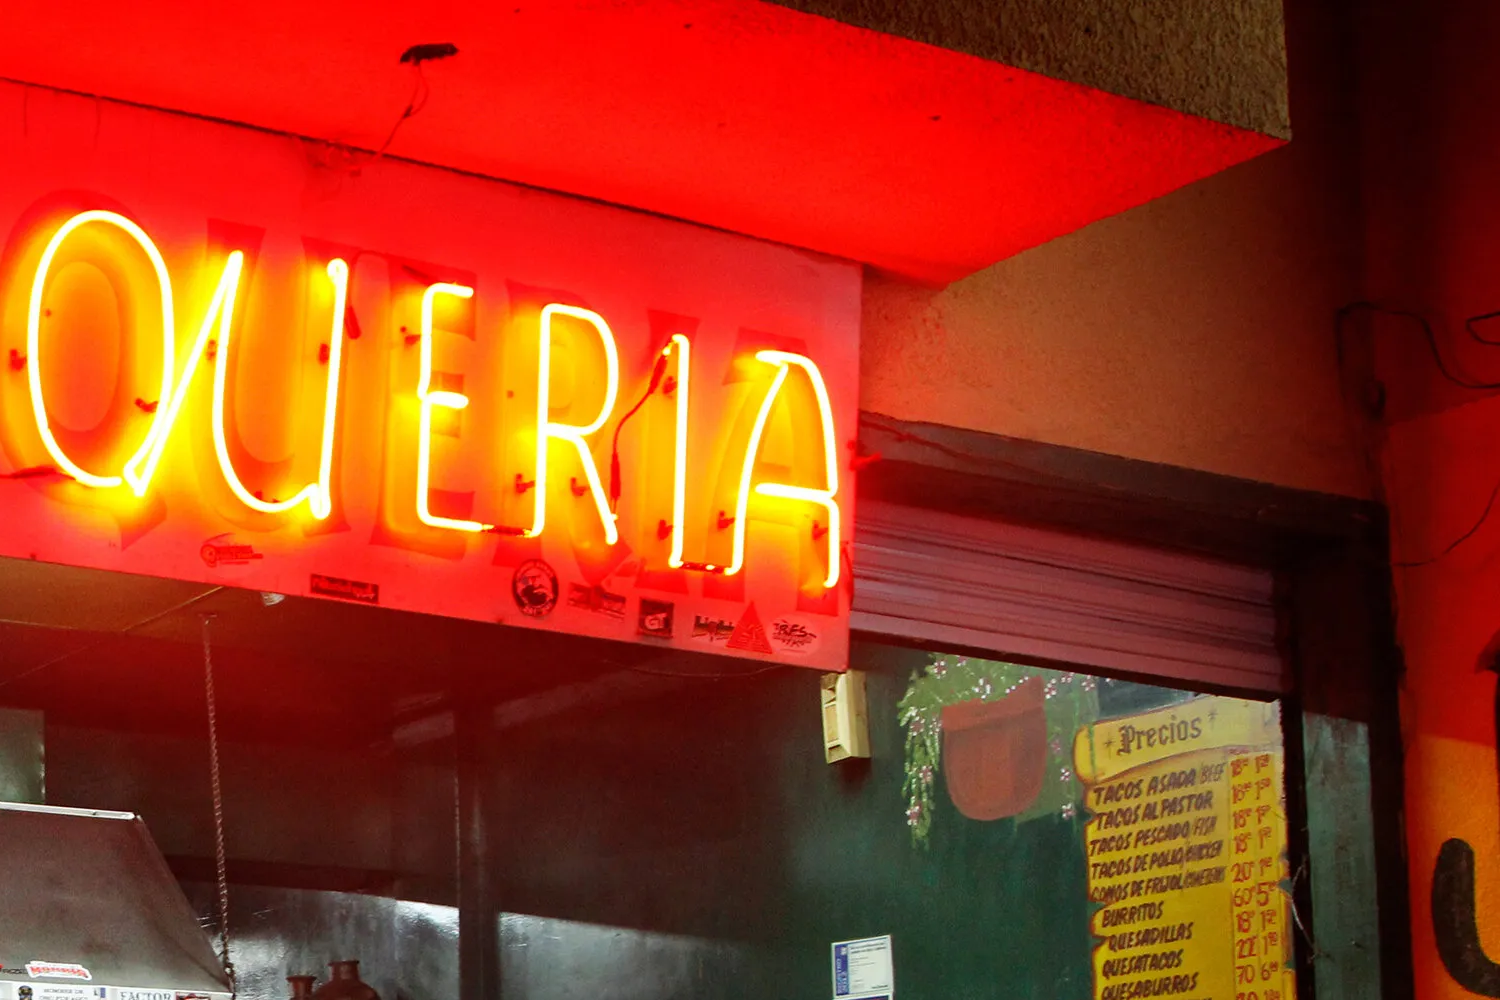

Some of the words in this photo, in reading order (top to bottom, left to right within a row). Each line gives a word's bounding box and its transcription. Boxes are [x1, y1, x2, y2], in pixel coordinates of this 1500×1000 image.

[1116, 715, 1203, 756] Precios
[1093, 779, 1144, 806] TACOS
[1146, 768, 1197, 797] ASADA
[1096, 803, 1142, 831] TACOS
[1141, 801, 1160, 822] AL
[1161, 790, 1214, 818] PASTOR
[1089, 832, 1133, 857] TACOS
[1133, 821, 1190, 849] PESCADO
[1091, 856, 1133, 879] TACOS
[1133, 854, 1149, 873] DE
[1149, 847, 1184, 870] POLLO
[1130, 880, 1145, 898] DE
[1101, 901, 1165, 929] BURRITOS
[1108, 922, 1194, 952] QUESADILLAS
[1102, 949, 1184, 980] QUESATACOS
